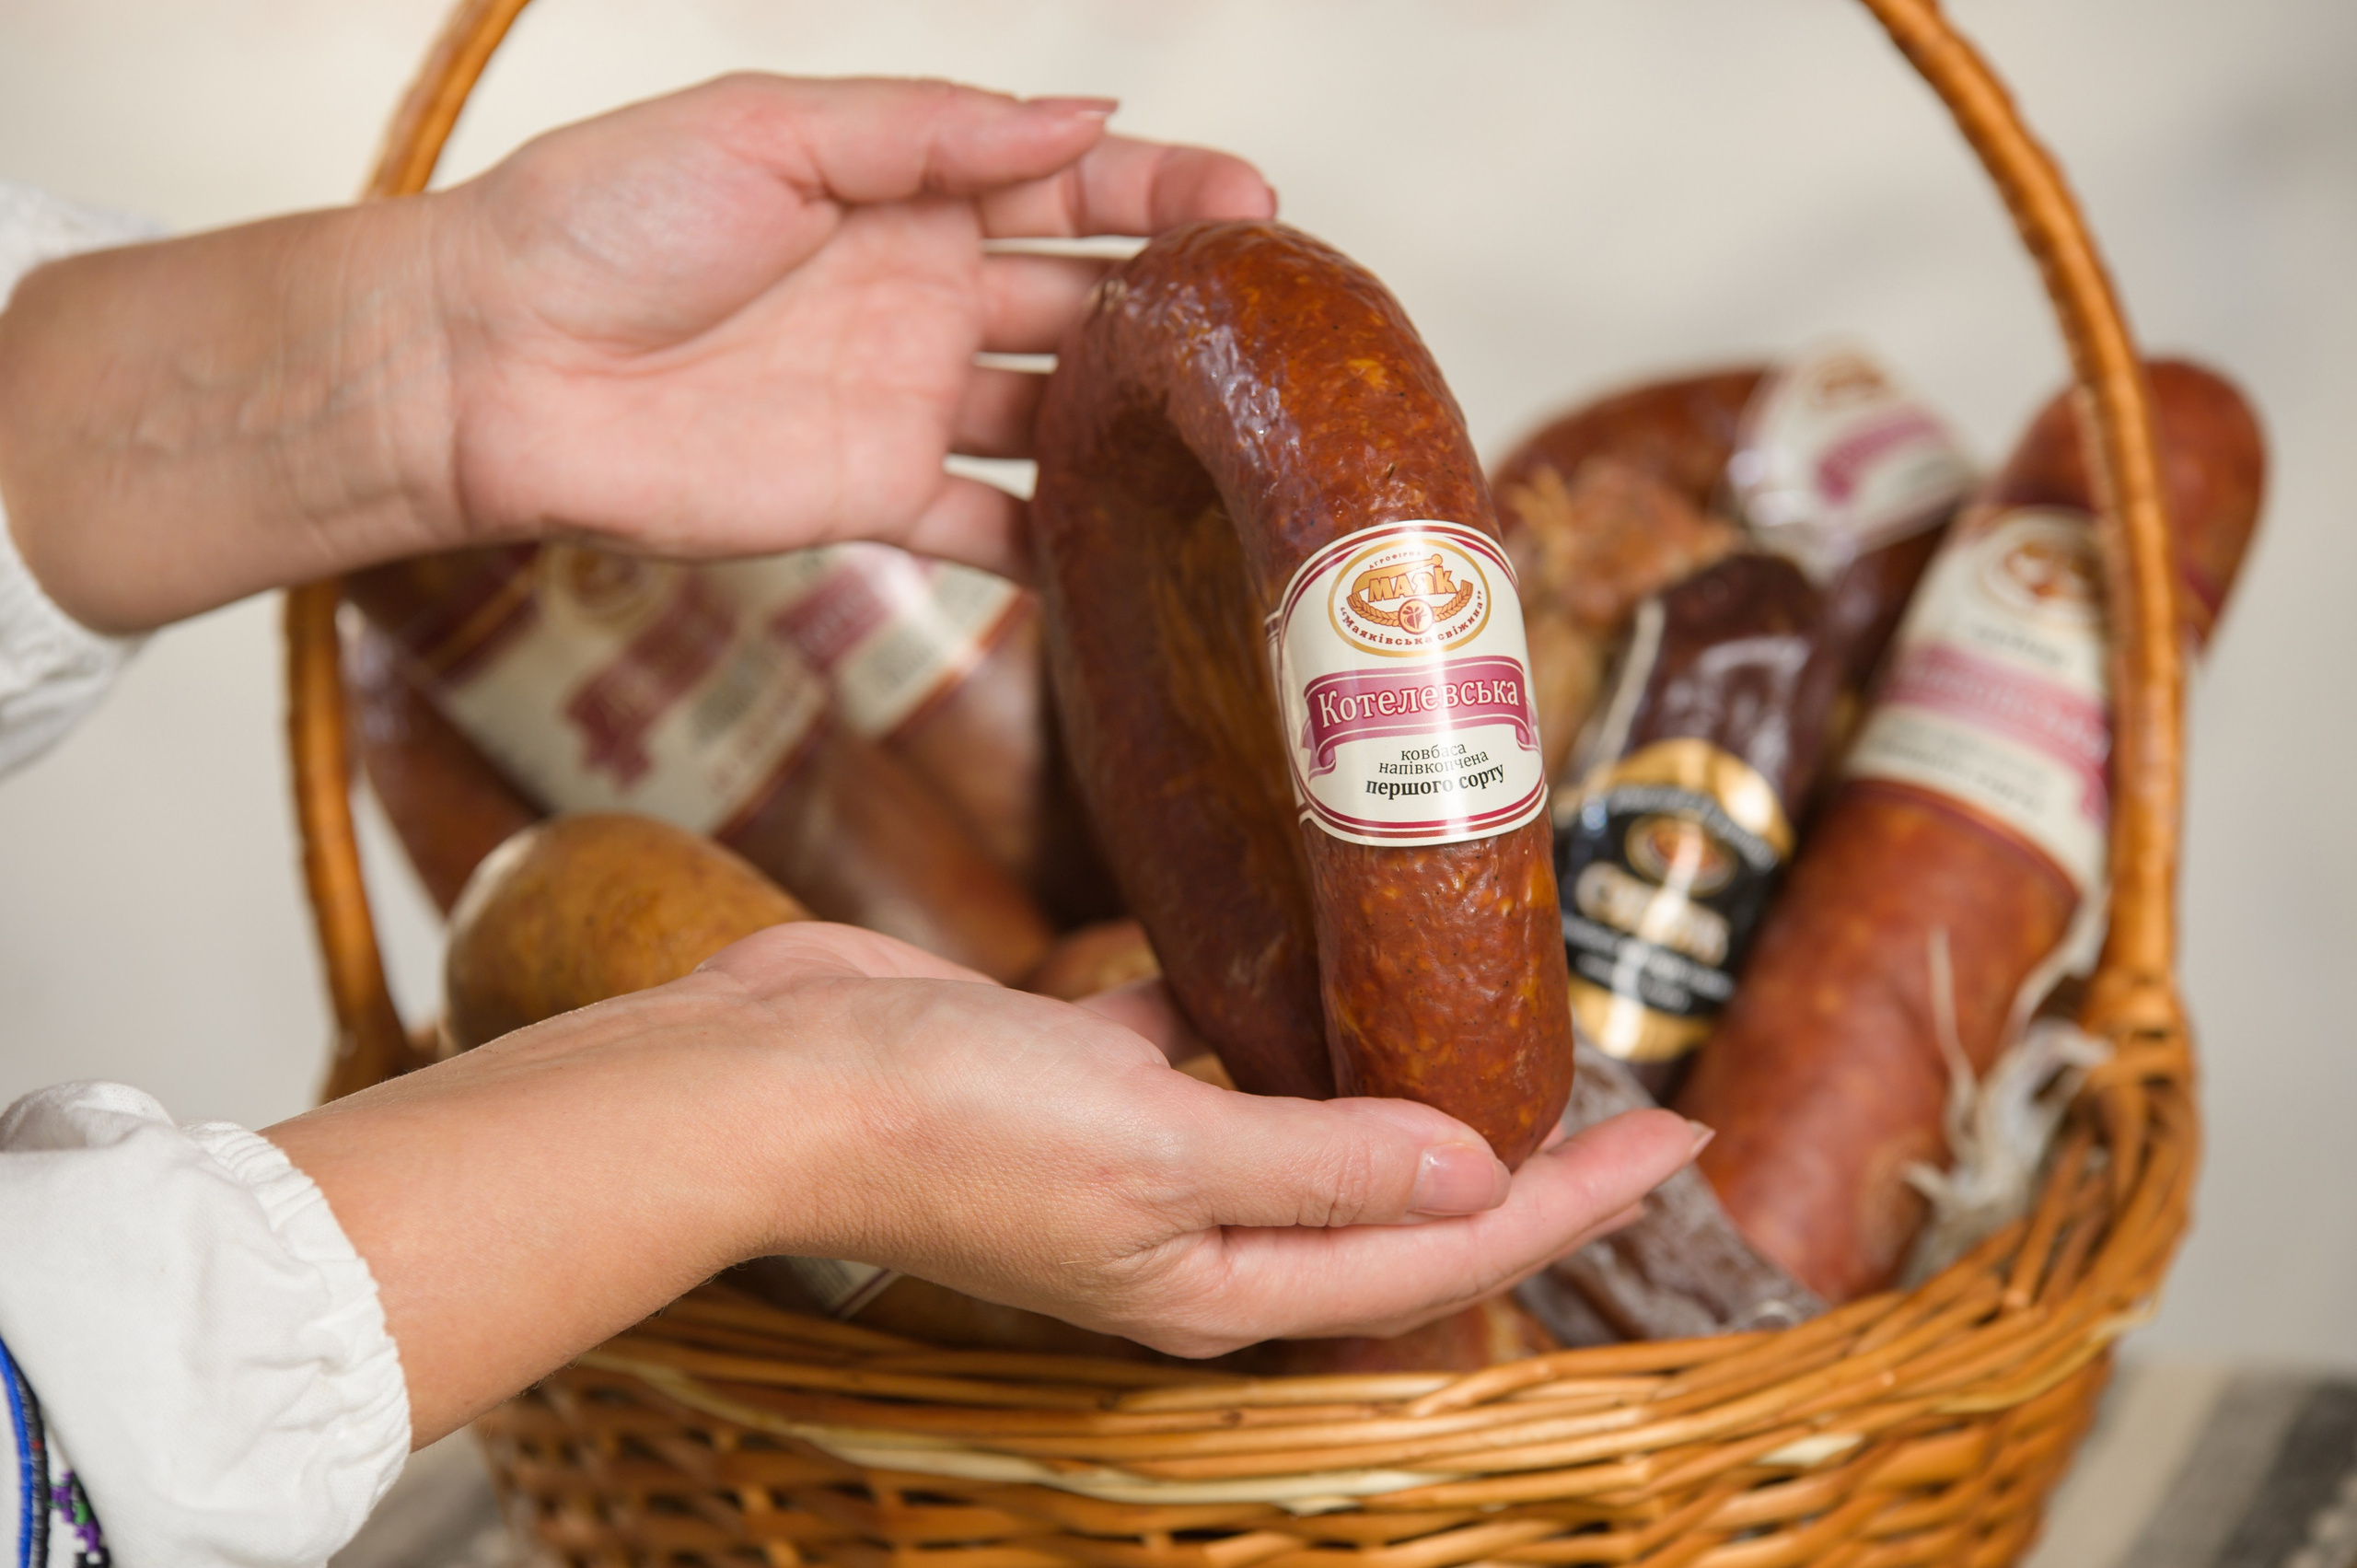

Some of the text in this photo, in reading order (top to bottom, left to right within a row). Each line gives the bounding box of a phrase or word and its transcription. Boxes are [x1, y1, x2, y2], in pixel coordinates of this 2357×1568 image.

[1367, 565, 1457, 603] МАЯК
[1318, 679, 1519, 728] Котелевська
[1378, 750, 1489, 774] напівкопчена
[1400, 744, 1467, 761] ковбаса
[1365, 763, 1504, 799] першого сорту
